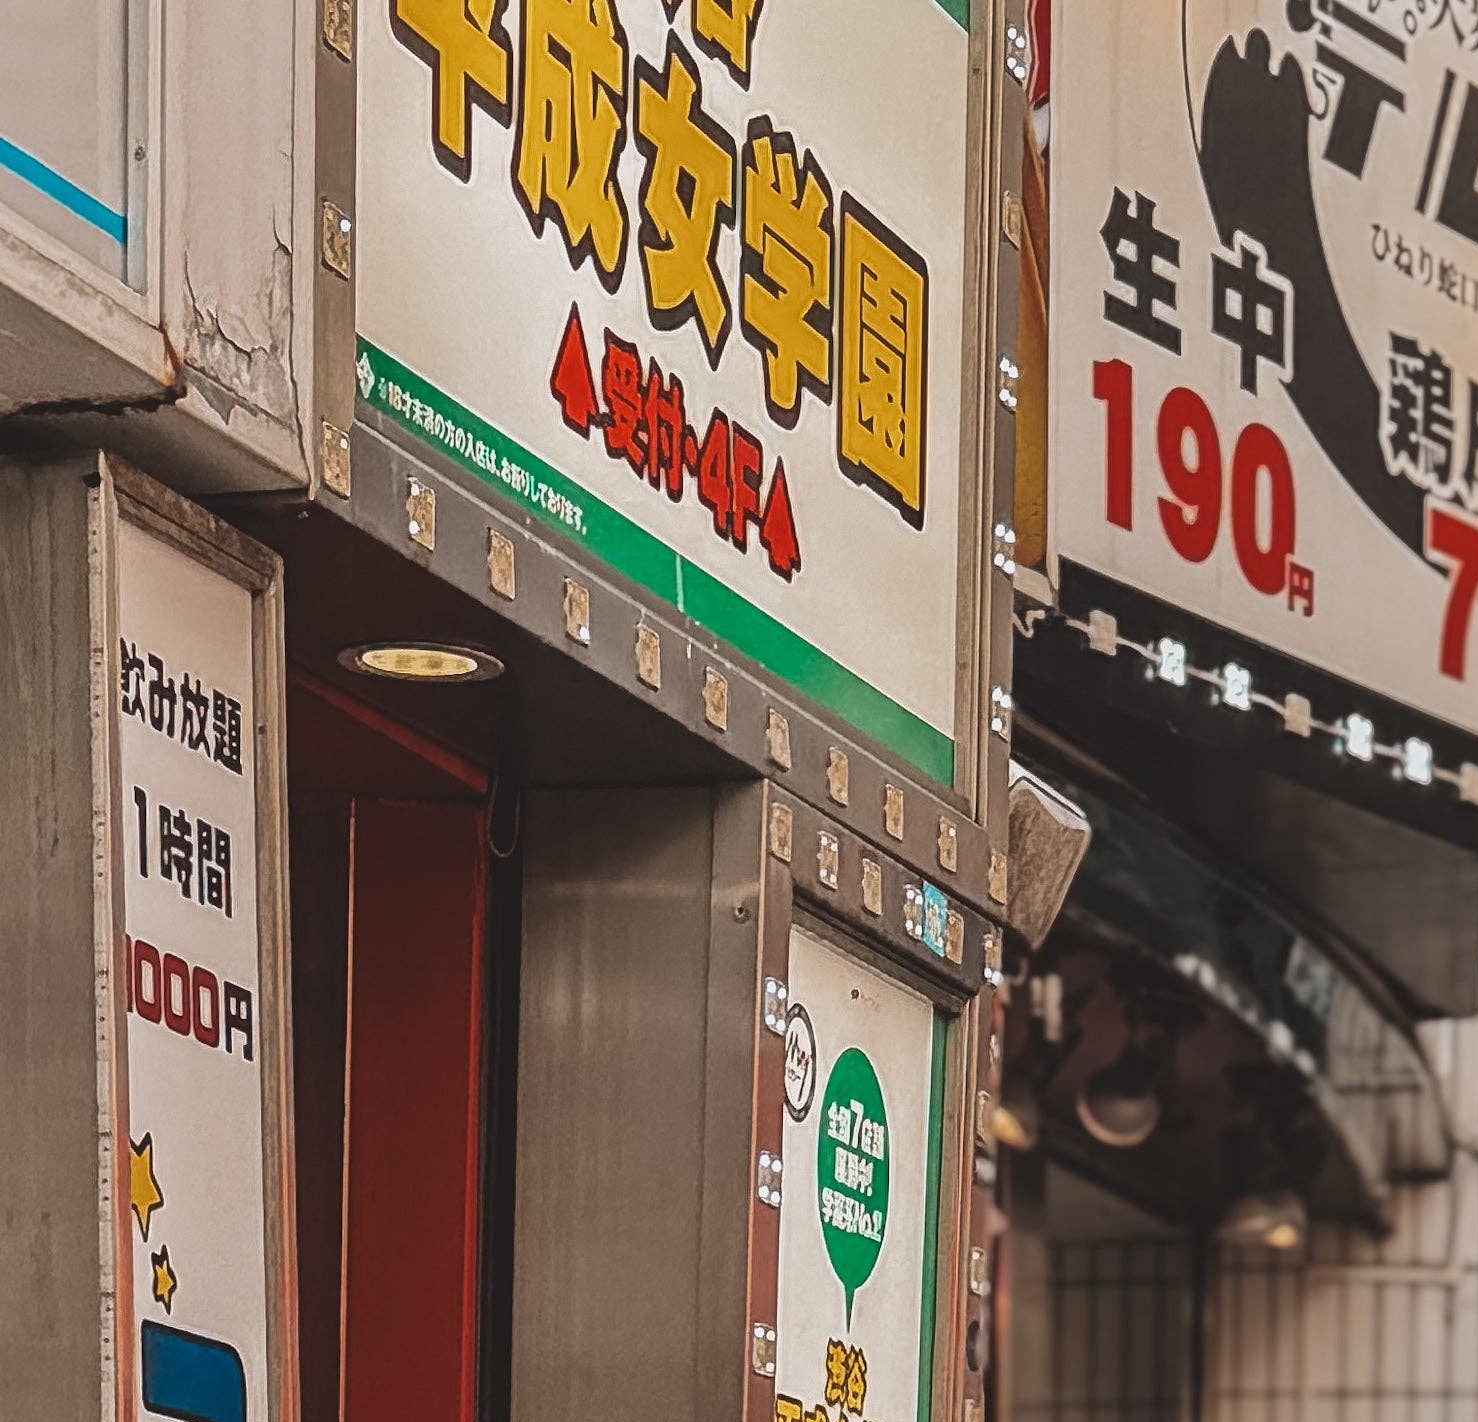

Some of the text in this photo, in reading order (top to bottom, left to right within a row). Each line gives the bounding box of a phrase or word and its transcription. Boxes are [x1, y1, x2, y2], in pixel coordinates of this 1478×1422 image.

[1100, 186, 1293, 396] 生中
[1092, 358, 1315, 617] 190円
[133, 785, 233, 919] 1時間
